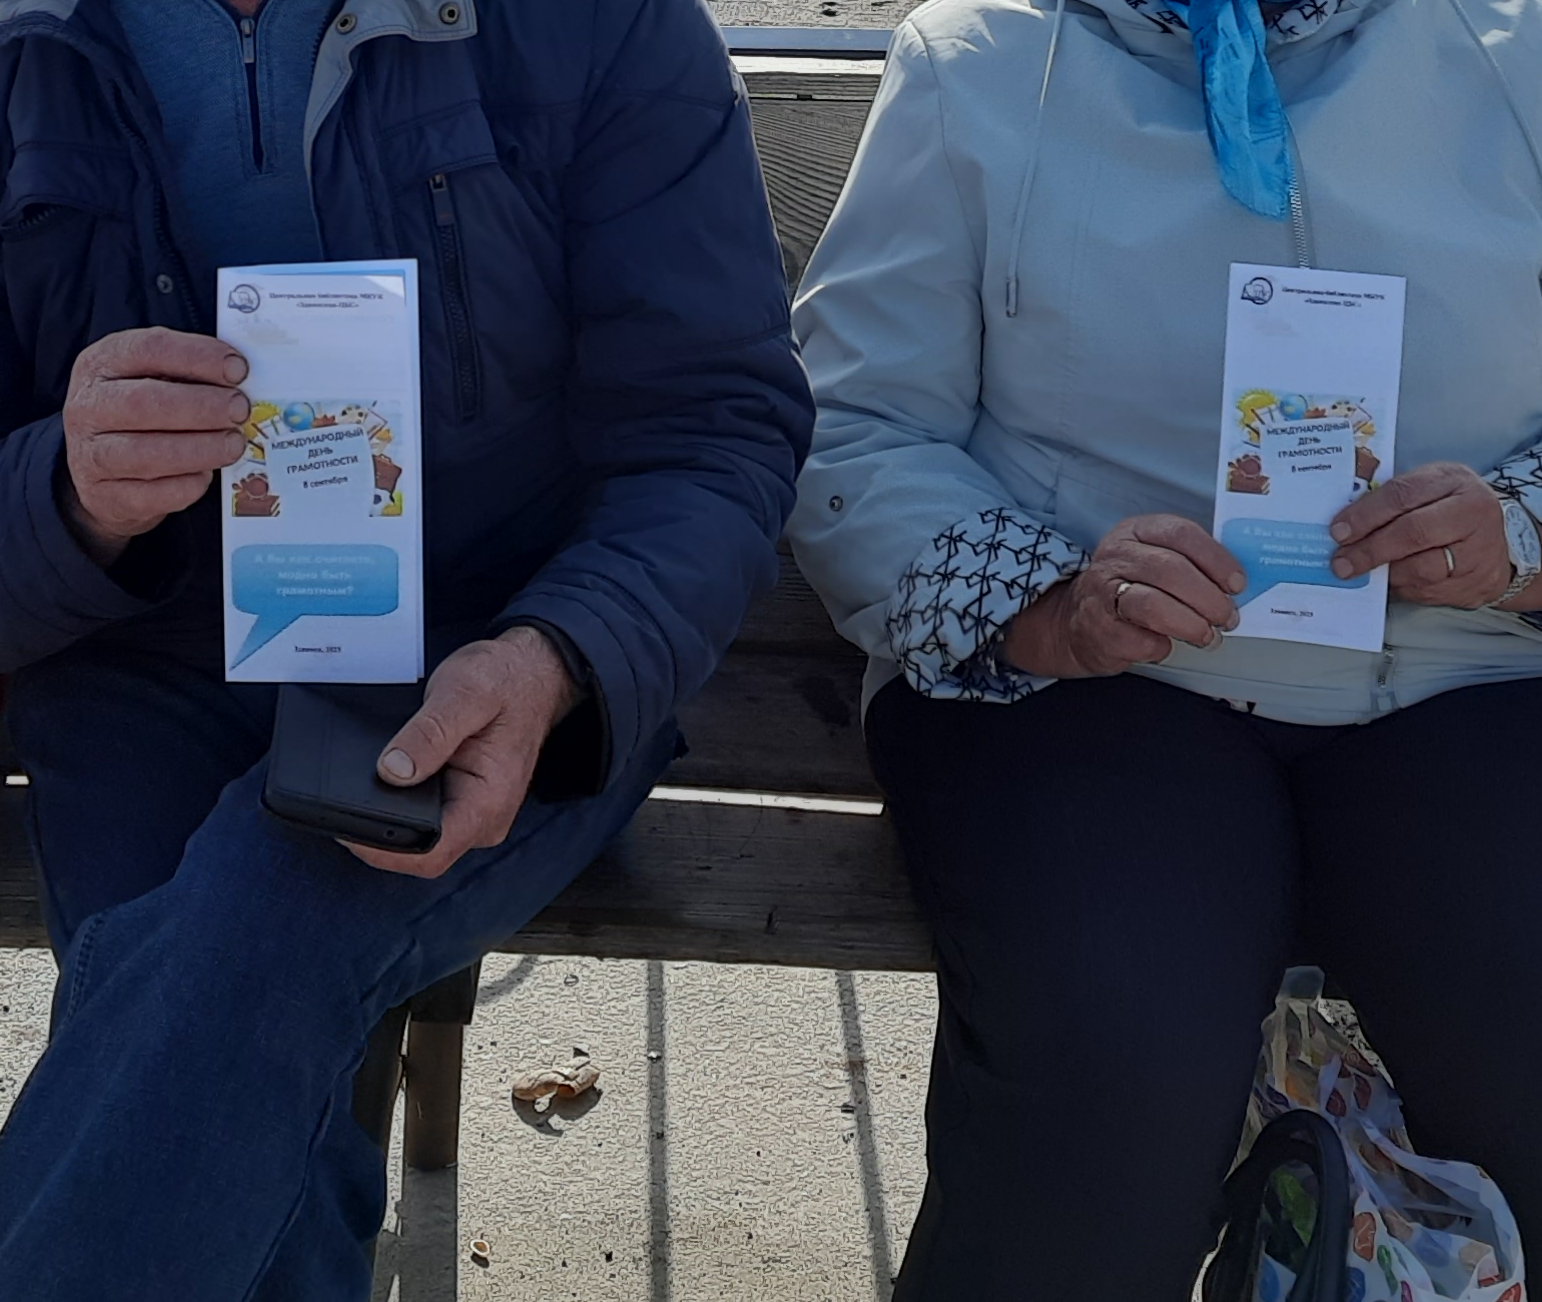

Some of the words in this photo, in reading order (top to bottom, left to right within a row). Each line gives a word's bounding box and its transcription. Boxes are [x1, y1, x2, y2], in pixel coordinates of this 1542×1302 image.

[1266, 420, 1351, 436] МЕЖДУНАРОДНЫЙ
[271, 428, 364, 450] МЕЖДУНАРОДНЫЙ
[308, 446, 333, 459] ДЕНЬ
[1278, 446, 1342, 458] ГРАМОТНОСТИ
[286, 455, 358, 474] ГРАМОТНОСТИ
[310, 476, 348, 488] сентября
